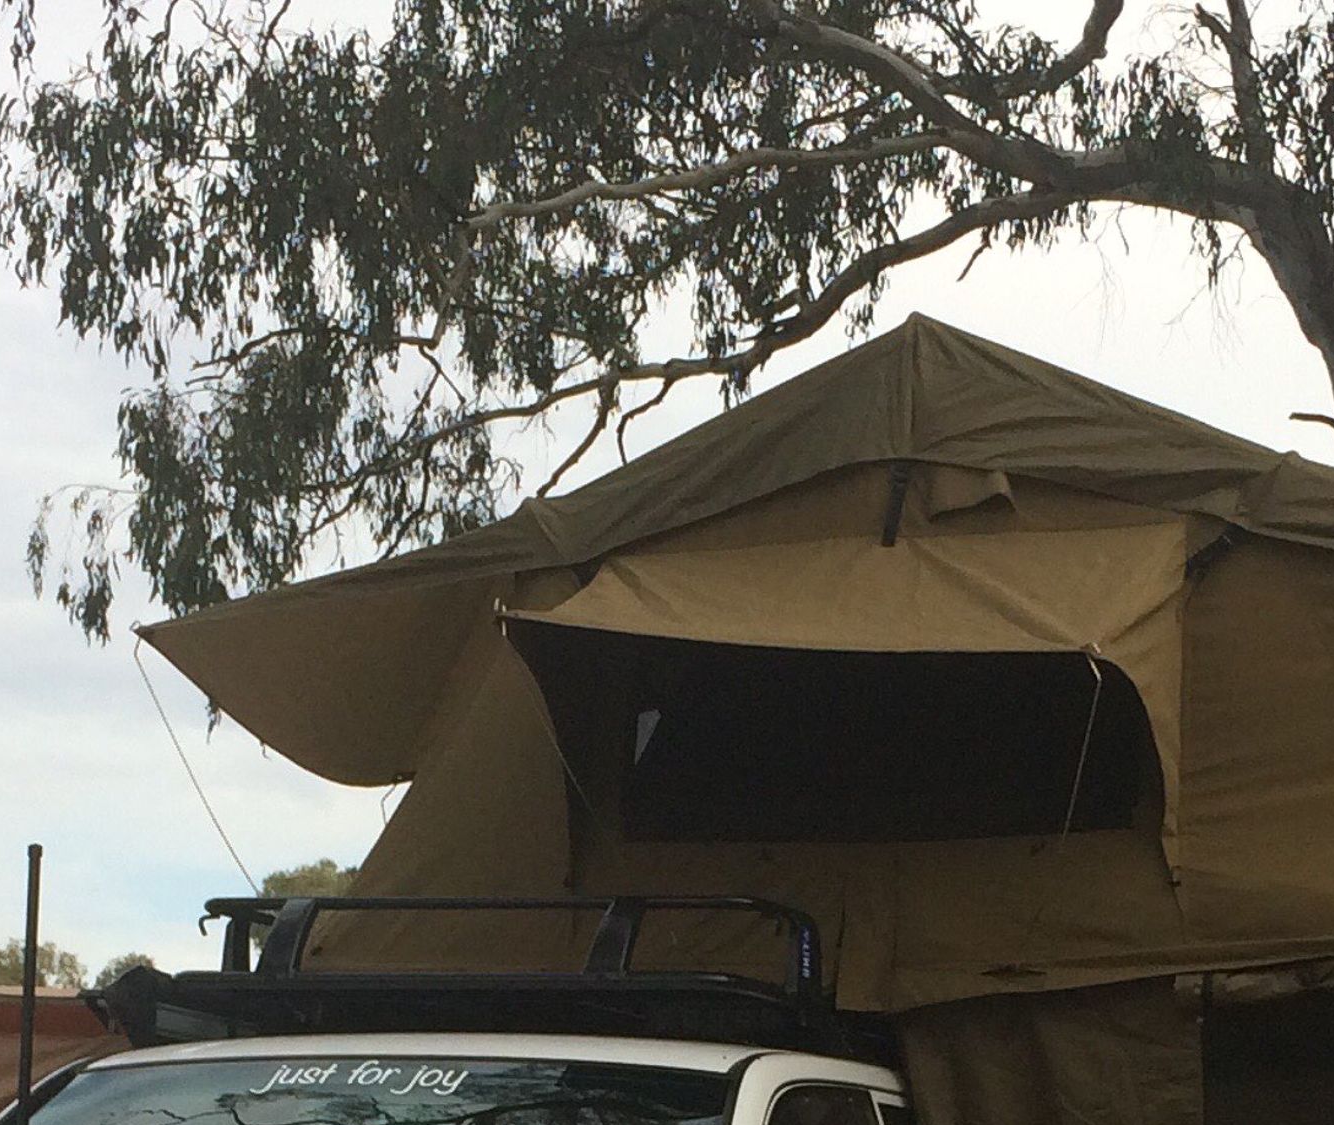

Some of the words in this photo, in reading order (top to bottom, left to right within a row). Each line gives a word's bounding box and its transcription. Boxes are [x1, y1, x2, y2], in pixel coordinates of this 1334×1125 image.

[249, 1063, 338, 1095] just
[347, 1060, 402, 1085] for
[389, 1064, 470, 1096] joy
